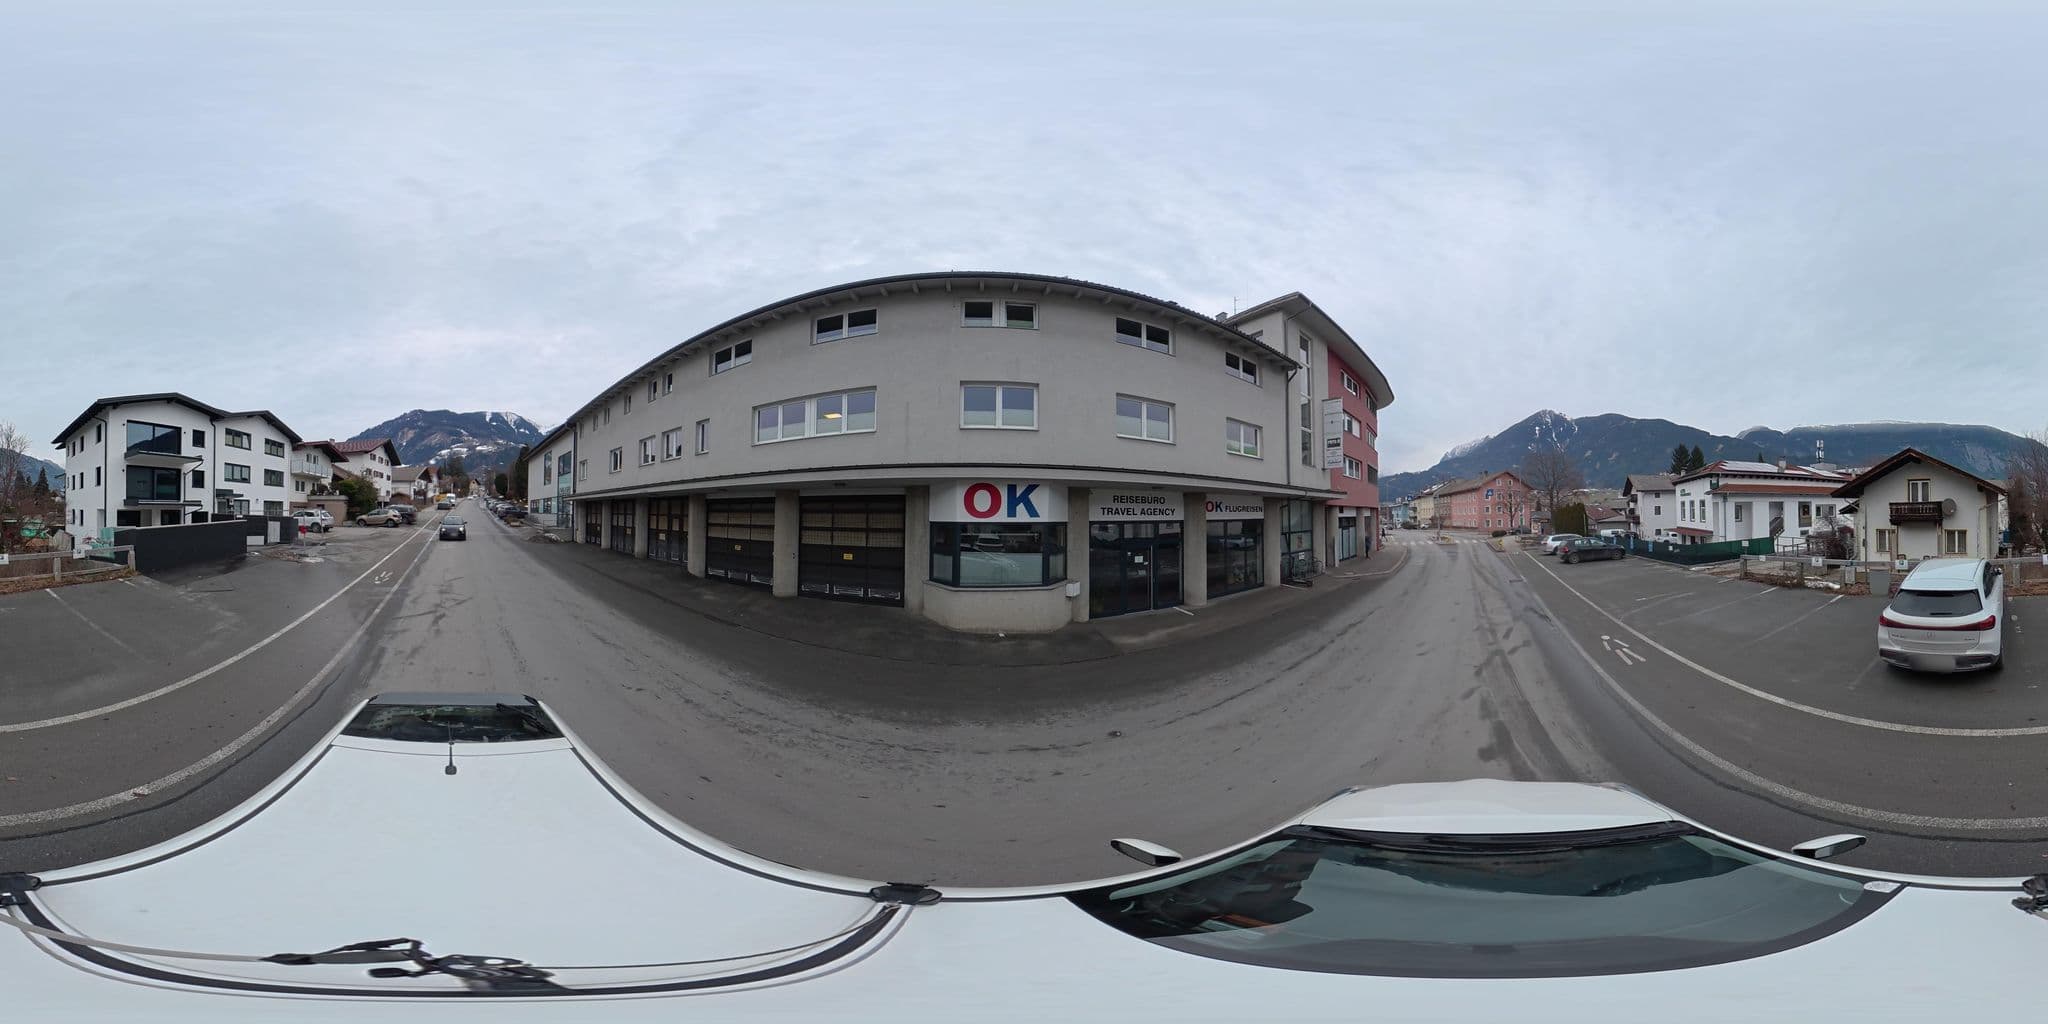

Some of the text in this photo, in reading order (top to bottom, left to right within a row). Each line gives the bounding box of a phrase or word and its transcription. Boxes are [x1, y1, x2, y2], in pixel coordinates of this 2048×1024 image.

[963, 482, 1041, 519] OK
[1205, 500, 1263, 513] OK FLUGREISEN
[1100, 507, 1176, 516] TRAVEL AGENCY
